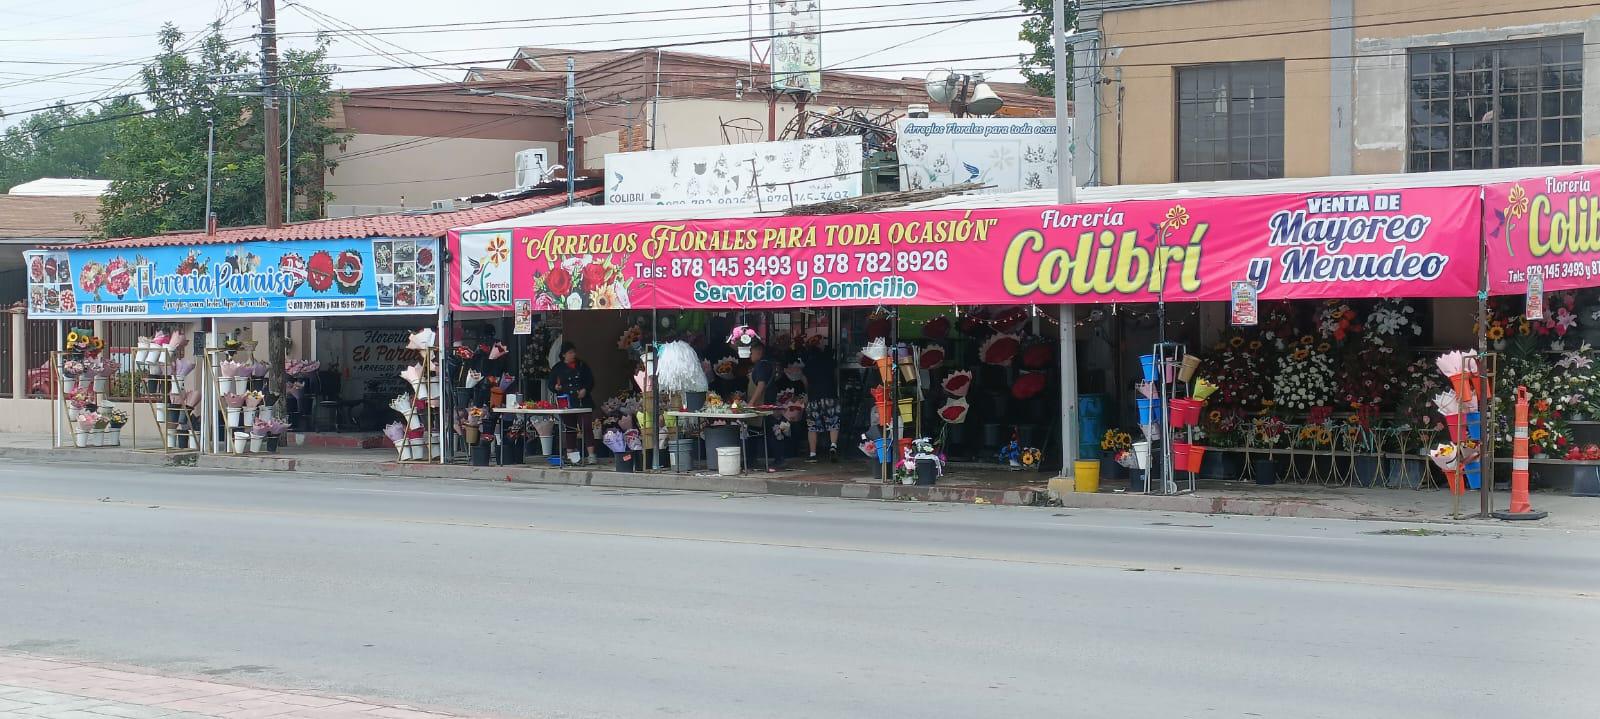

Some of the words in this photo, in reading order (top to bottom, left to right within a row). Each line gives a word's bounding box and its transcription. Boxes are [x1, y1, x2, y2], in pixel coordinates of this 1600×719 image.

[904, 123, 944, 136] Arreglos
[946, 123, 984, 134] Florales
[984, 124, 1009, 137] para
[1010, 123, 1031, 134] toda
[609, 193, 644, 203] COLIBRI
[1307, 196, 1370, 214] VENTA
[1374, 194, 1401, 211] DE
[1040, 207, 1124, 228] Florería
[641, 224, 758, 260] FLORALES
[763, 225, 817, 249] PARA
[825, 223, 881, 247] TODA
[1269, 210, 1431, 253] Mayoreo
[634, 262, 667, 279] Tels:
[671, 257, 702, 277] 878
[710, 256, 739, 278] 145
[743, 255, 791, 276] 3493
[796, 260, 808, 280] y
[813, 253, 849, 274] 878
[855, 252, 891, 273] 782
[896, 250, 948, 272] 8926
[1002, 223, 1209, 296] Colibrí
[1247, 257, 1272, 293] y
[1280, 245, 1449, 283] Menudeo
[1543, 263, 1560, 279] 145
[1561, 262, 1584, 277] 3493
[1585, 265, 1591, 280] y
[462, 289, 510, 302] COLIBRI
[694, 280, 786, 302] Servicio
[791, 282, 805, 300] a
[812, 275, 918, 300] Domicilio
[352, 345, 371, 361] El
